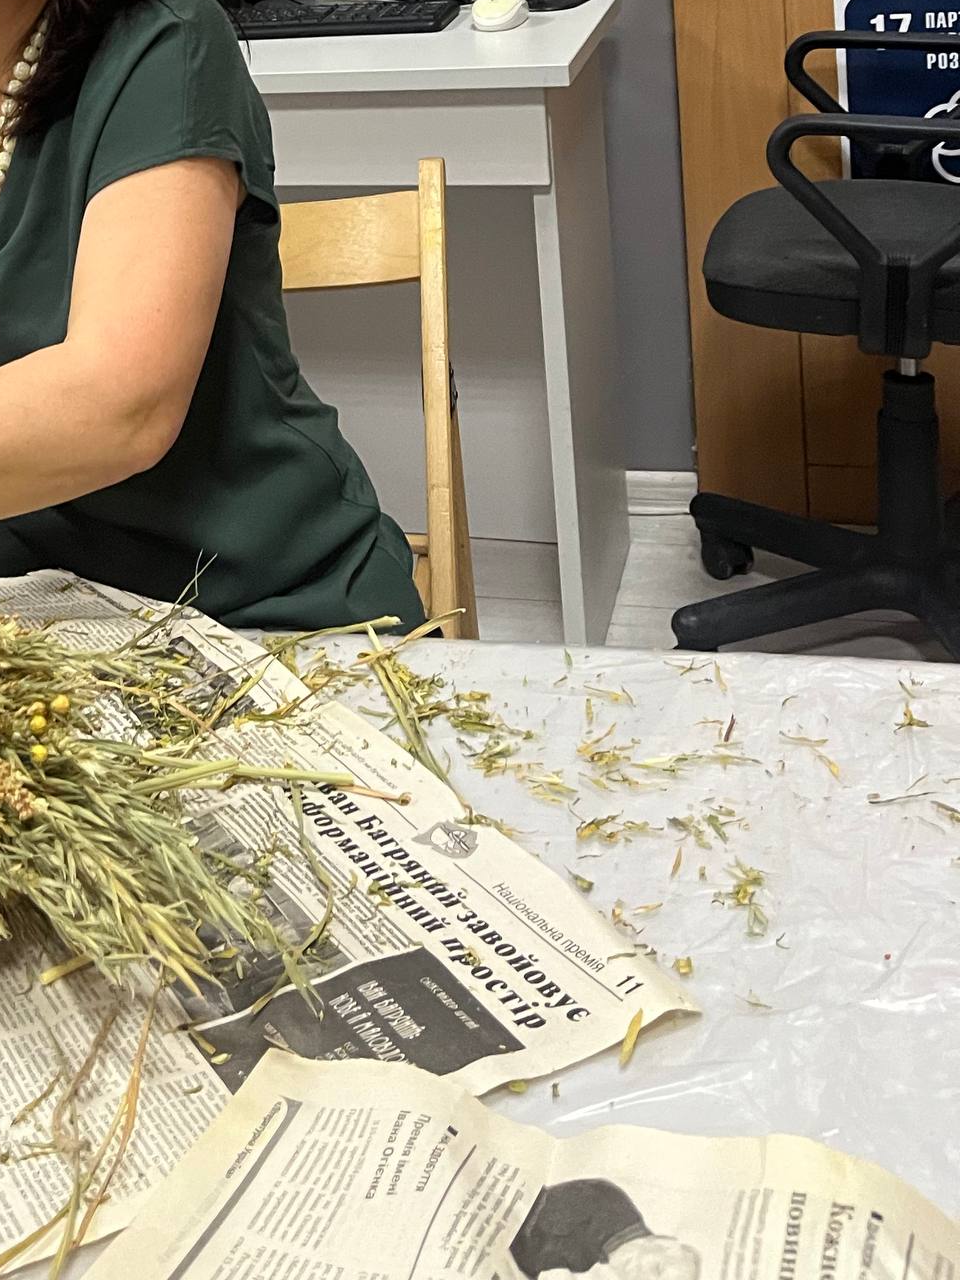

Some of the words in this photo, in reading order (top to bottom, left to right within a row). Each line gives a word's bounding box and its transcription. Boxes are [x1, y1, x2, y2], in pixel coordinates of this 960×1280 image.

[925, 11, 960, 29] ПАР
[354, 814, 468, 909] Багряний
[456, 909, 592, 1022] завойовує
[491, 881, 565, 942] Національна
[559, 938, 606, 973] премія
[616, 974, 645, 995] 11
[387, 1109, 411, 1144] Івана
[401, 1112, 432, 1158] Премія
[364, 1145, 395, 1200] Огієнка
[386, 1158, 410, 1197] імені
